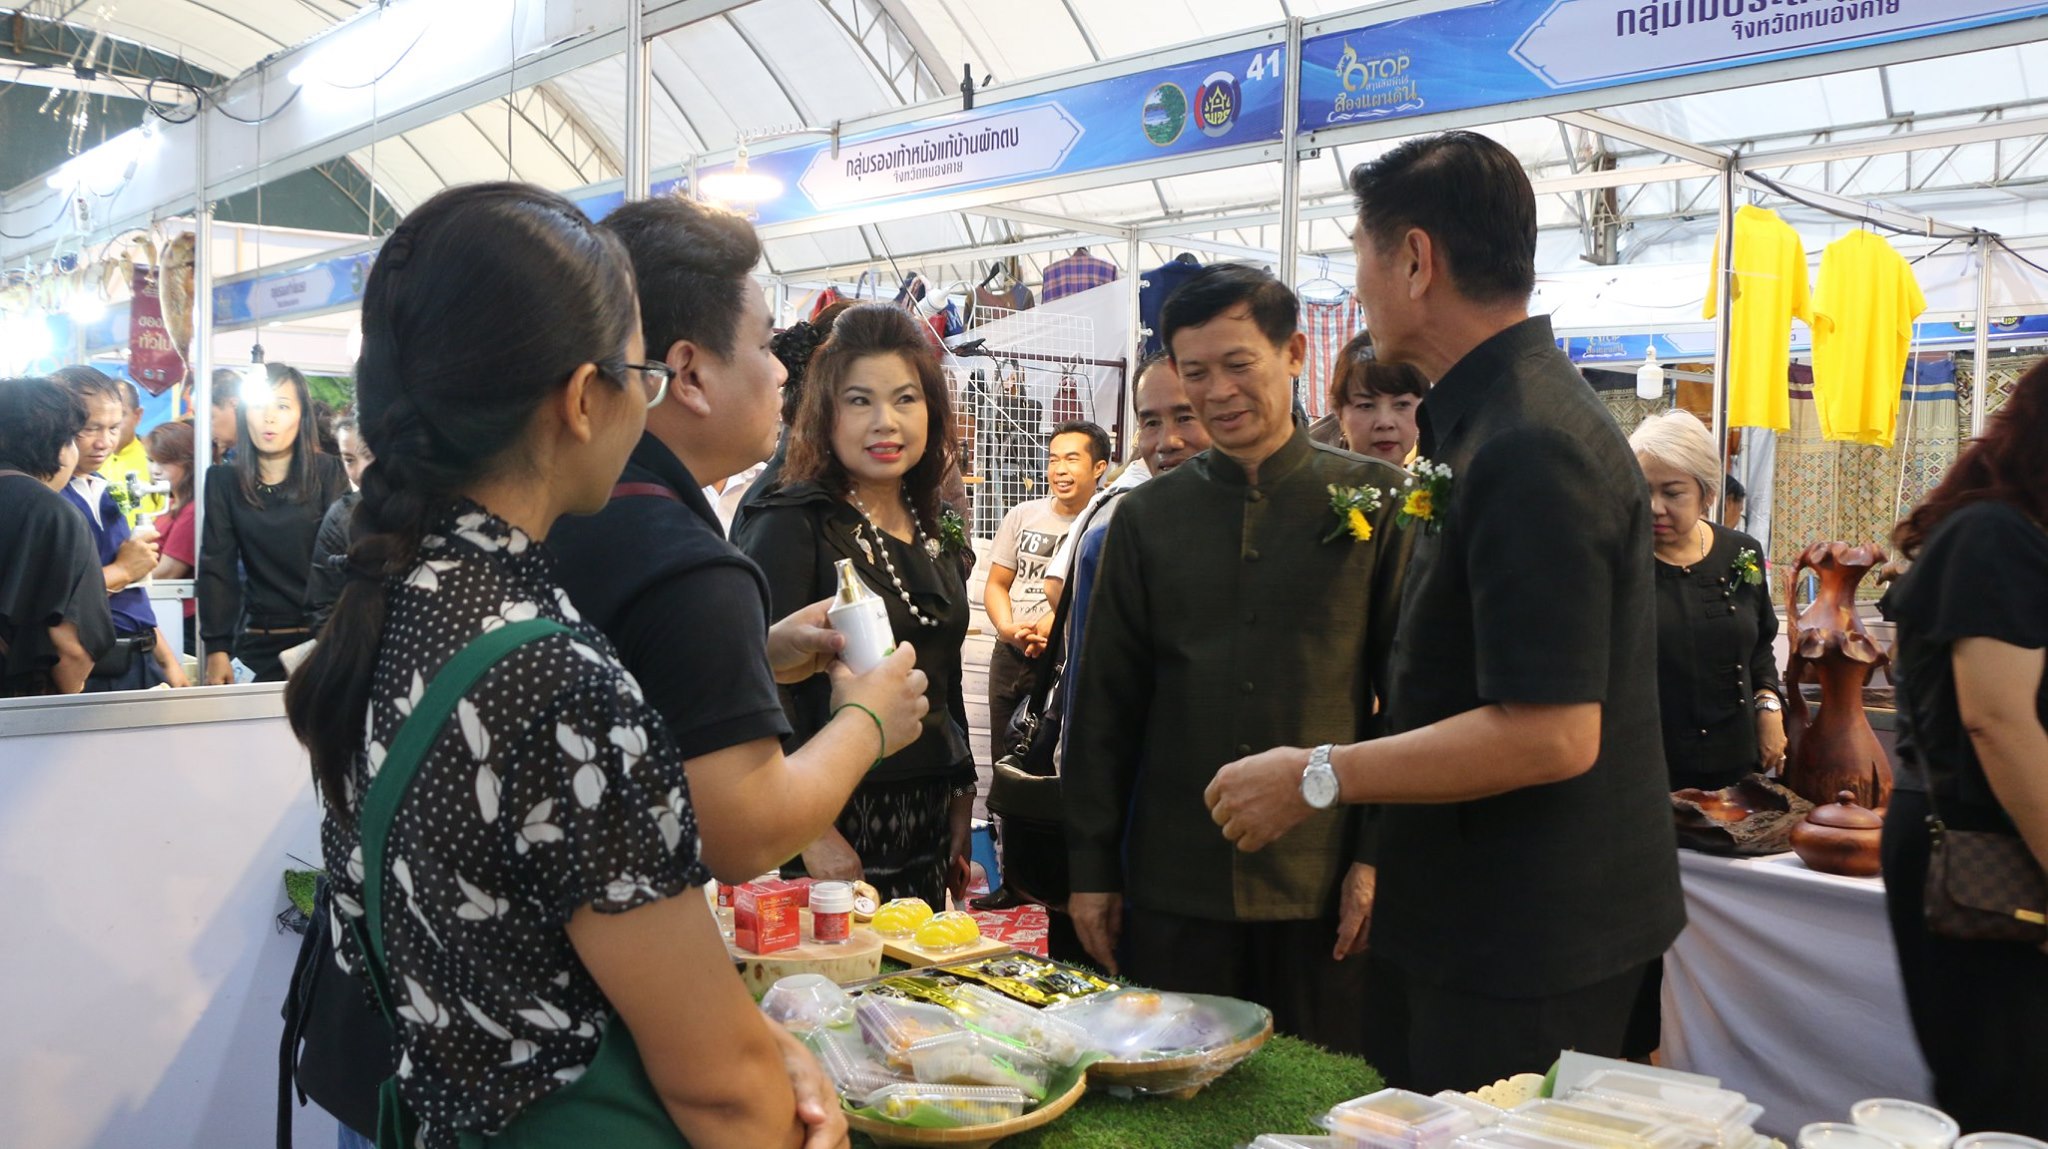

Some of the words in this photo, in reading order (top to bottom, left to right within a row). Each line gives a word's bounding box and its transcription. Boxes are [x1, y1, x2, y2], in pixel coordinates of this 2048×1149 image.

[1731, 0, 1900, 40] จังหวัดหนองคาย
[1246, 49, 1280, 81] 41
[846, 126, 1019, 181] กลุ่มรองเท้าหนังแท้บ้านผักตบ
[1021, 532, 1042, 553] 76
